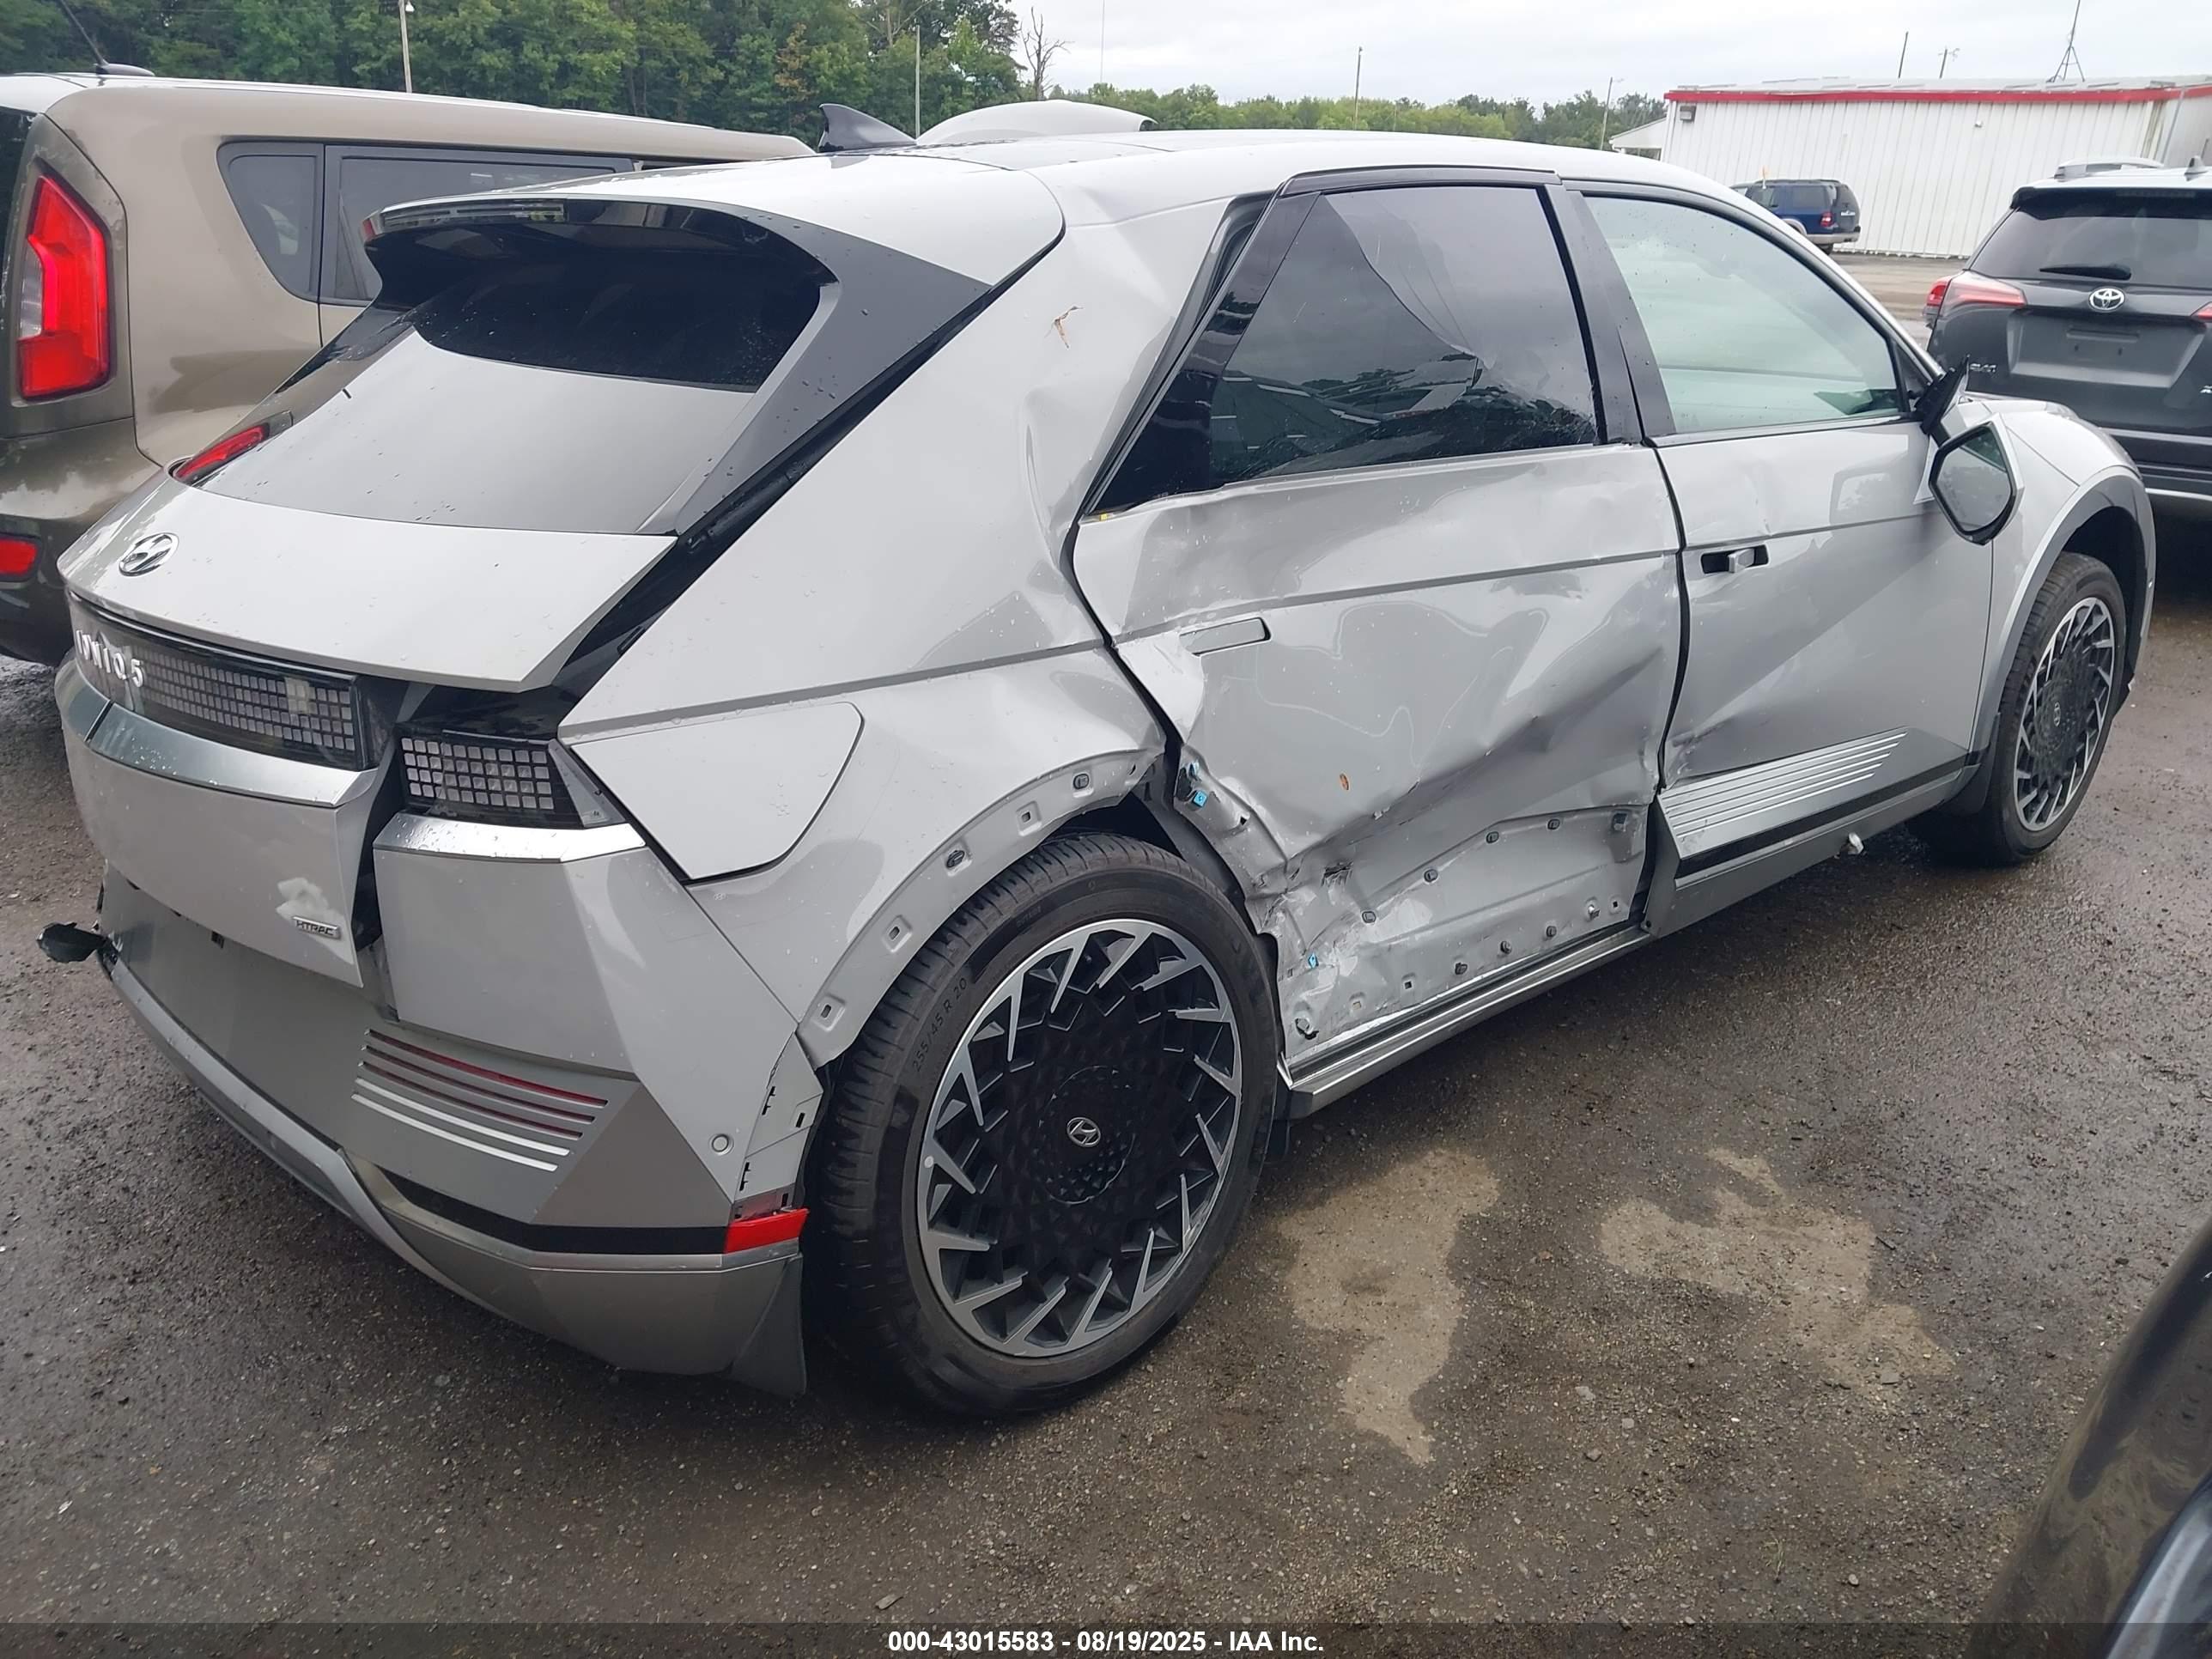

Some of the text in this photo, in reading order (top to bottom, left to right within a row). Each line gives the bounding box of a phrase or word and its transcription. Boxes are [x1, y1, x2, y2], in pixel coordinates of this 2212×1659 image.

[131, 658, 144, 688] 5
[912, 977, 967, 1073] 255/45 R 20
